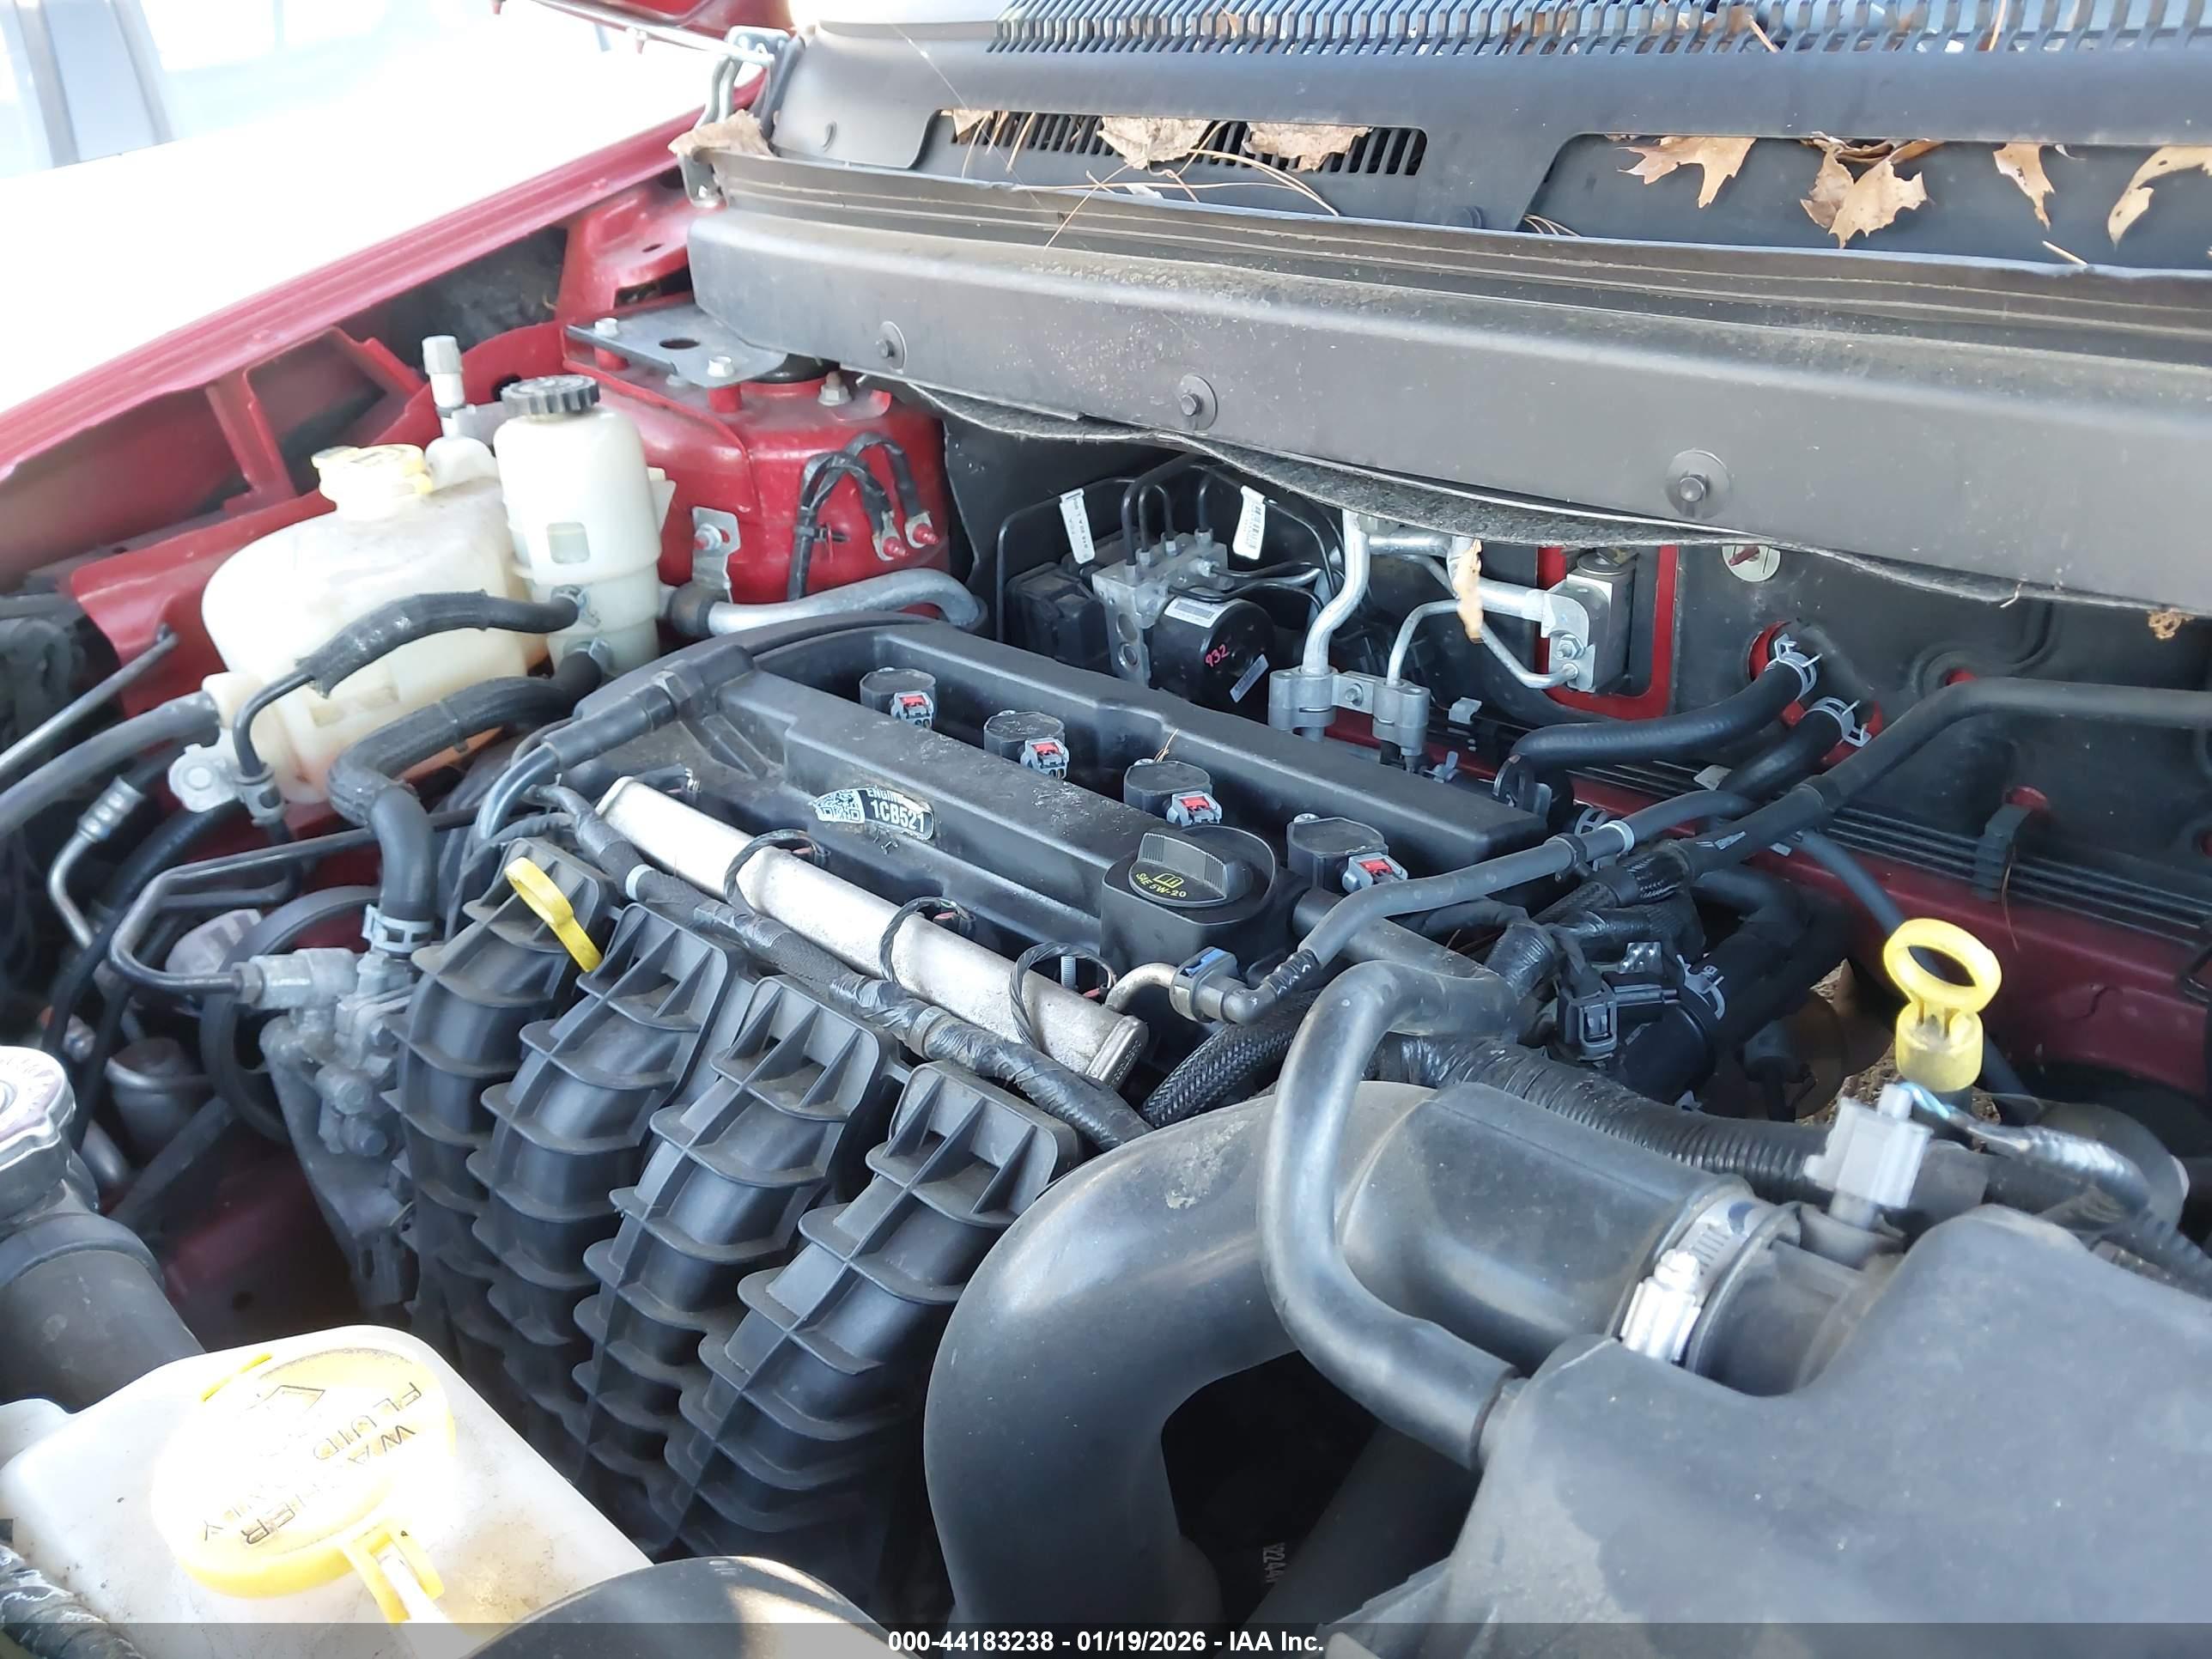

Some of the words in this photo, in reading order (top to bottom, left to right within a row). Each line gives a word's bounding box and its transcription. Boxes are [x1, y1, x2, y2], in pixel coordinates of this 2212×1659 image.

[871, 799, 925, 833] 1CB521
[1135, 872, 1152, 886] SAE
[1149, 884, 1187, 898] 5W-20
[313, 1382, 422, 1460] FLUID
[241, 1425, 416, 1545] WAHER
